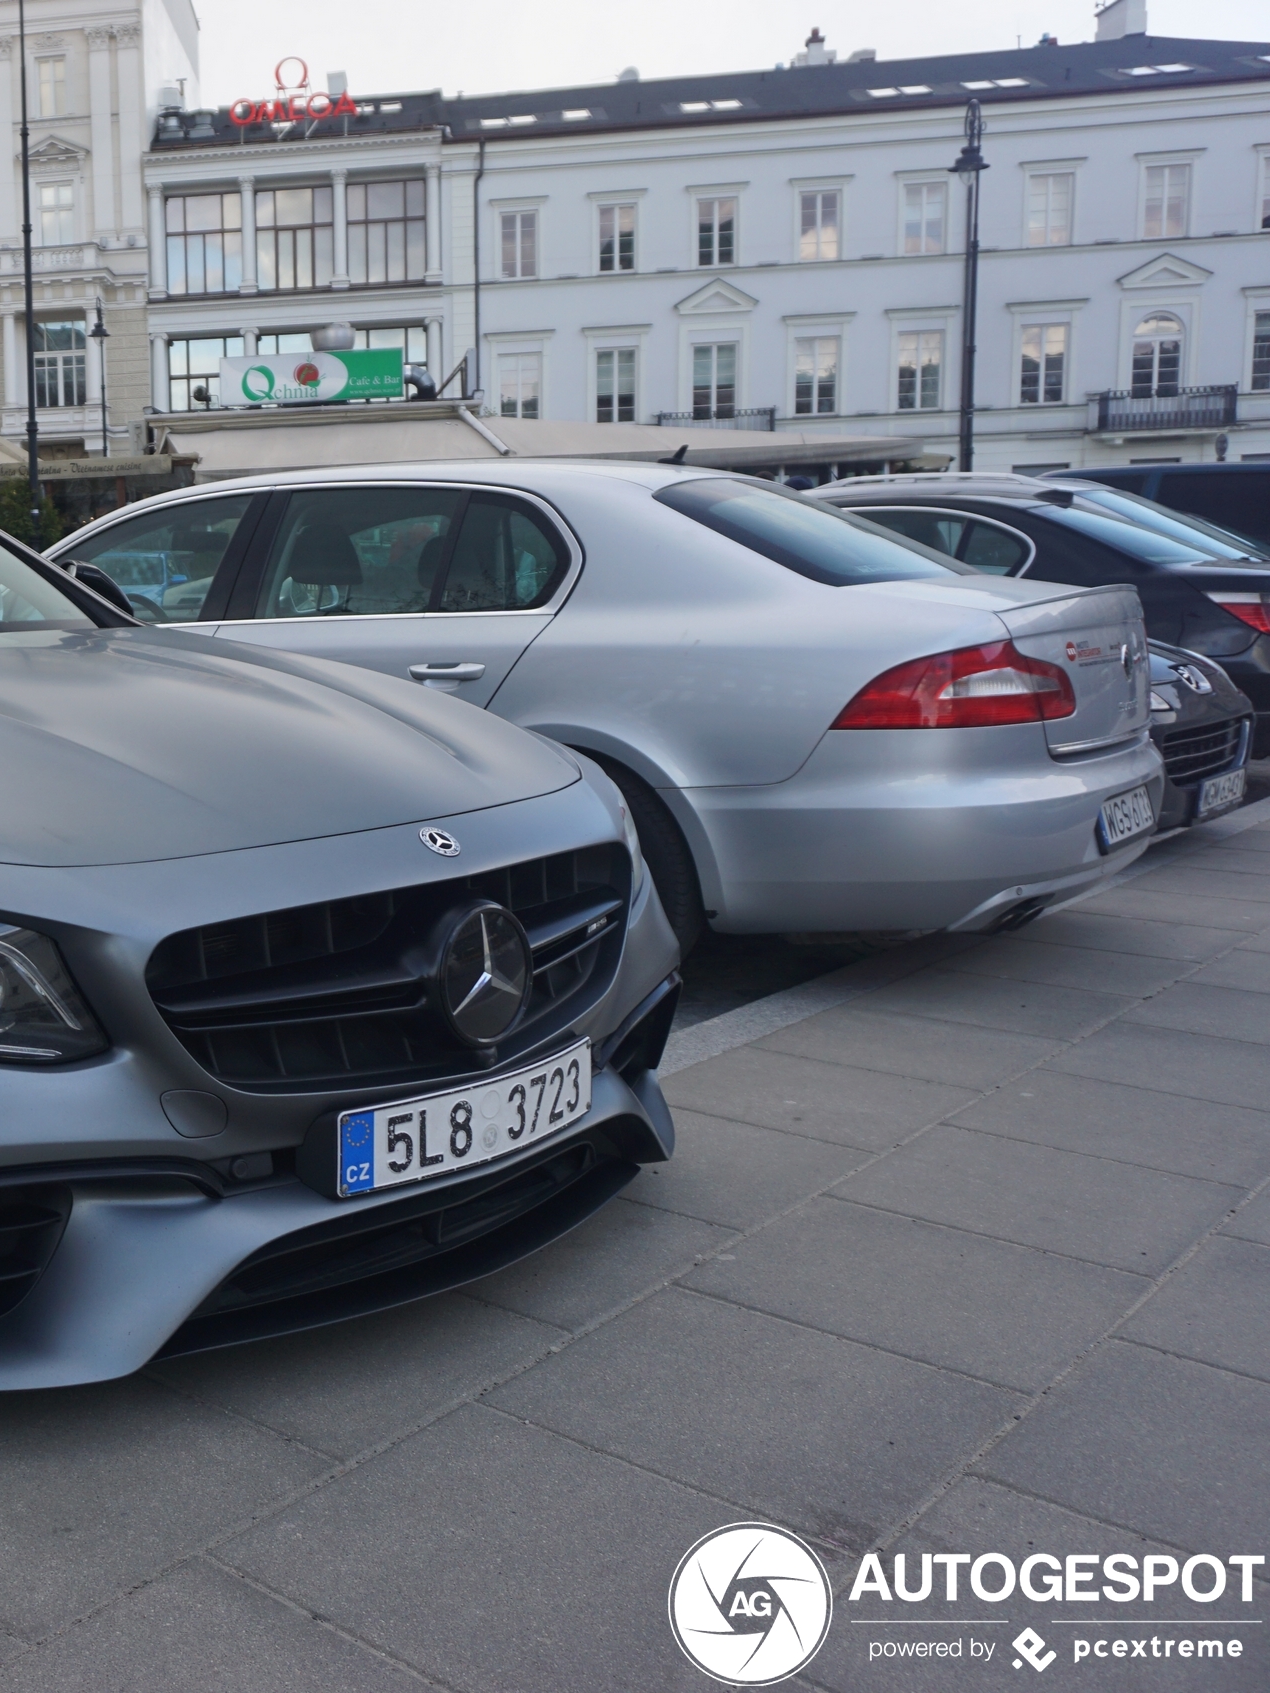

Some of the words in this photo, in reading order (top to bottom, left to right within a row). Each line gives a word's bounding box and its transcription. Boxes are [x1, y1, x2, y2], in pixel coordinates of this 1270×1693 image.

[230, 90, 357, 125] OMEGA
[241, 365, 318, 402] Qchnia
[372, 376, 381, 385] &
[384, 375, 400, 384] Bar
[70, 462, 114, 473] Vietnamese
[1103, 799, 1132, 839] WGS
[387, 1100, 473, 1172] 5L8
[508, 1059, 579, 1140] 3723
[346, 1162, 370, 1183] CZ
